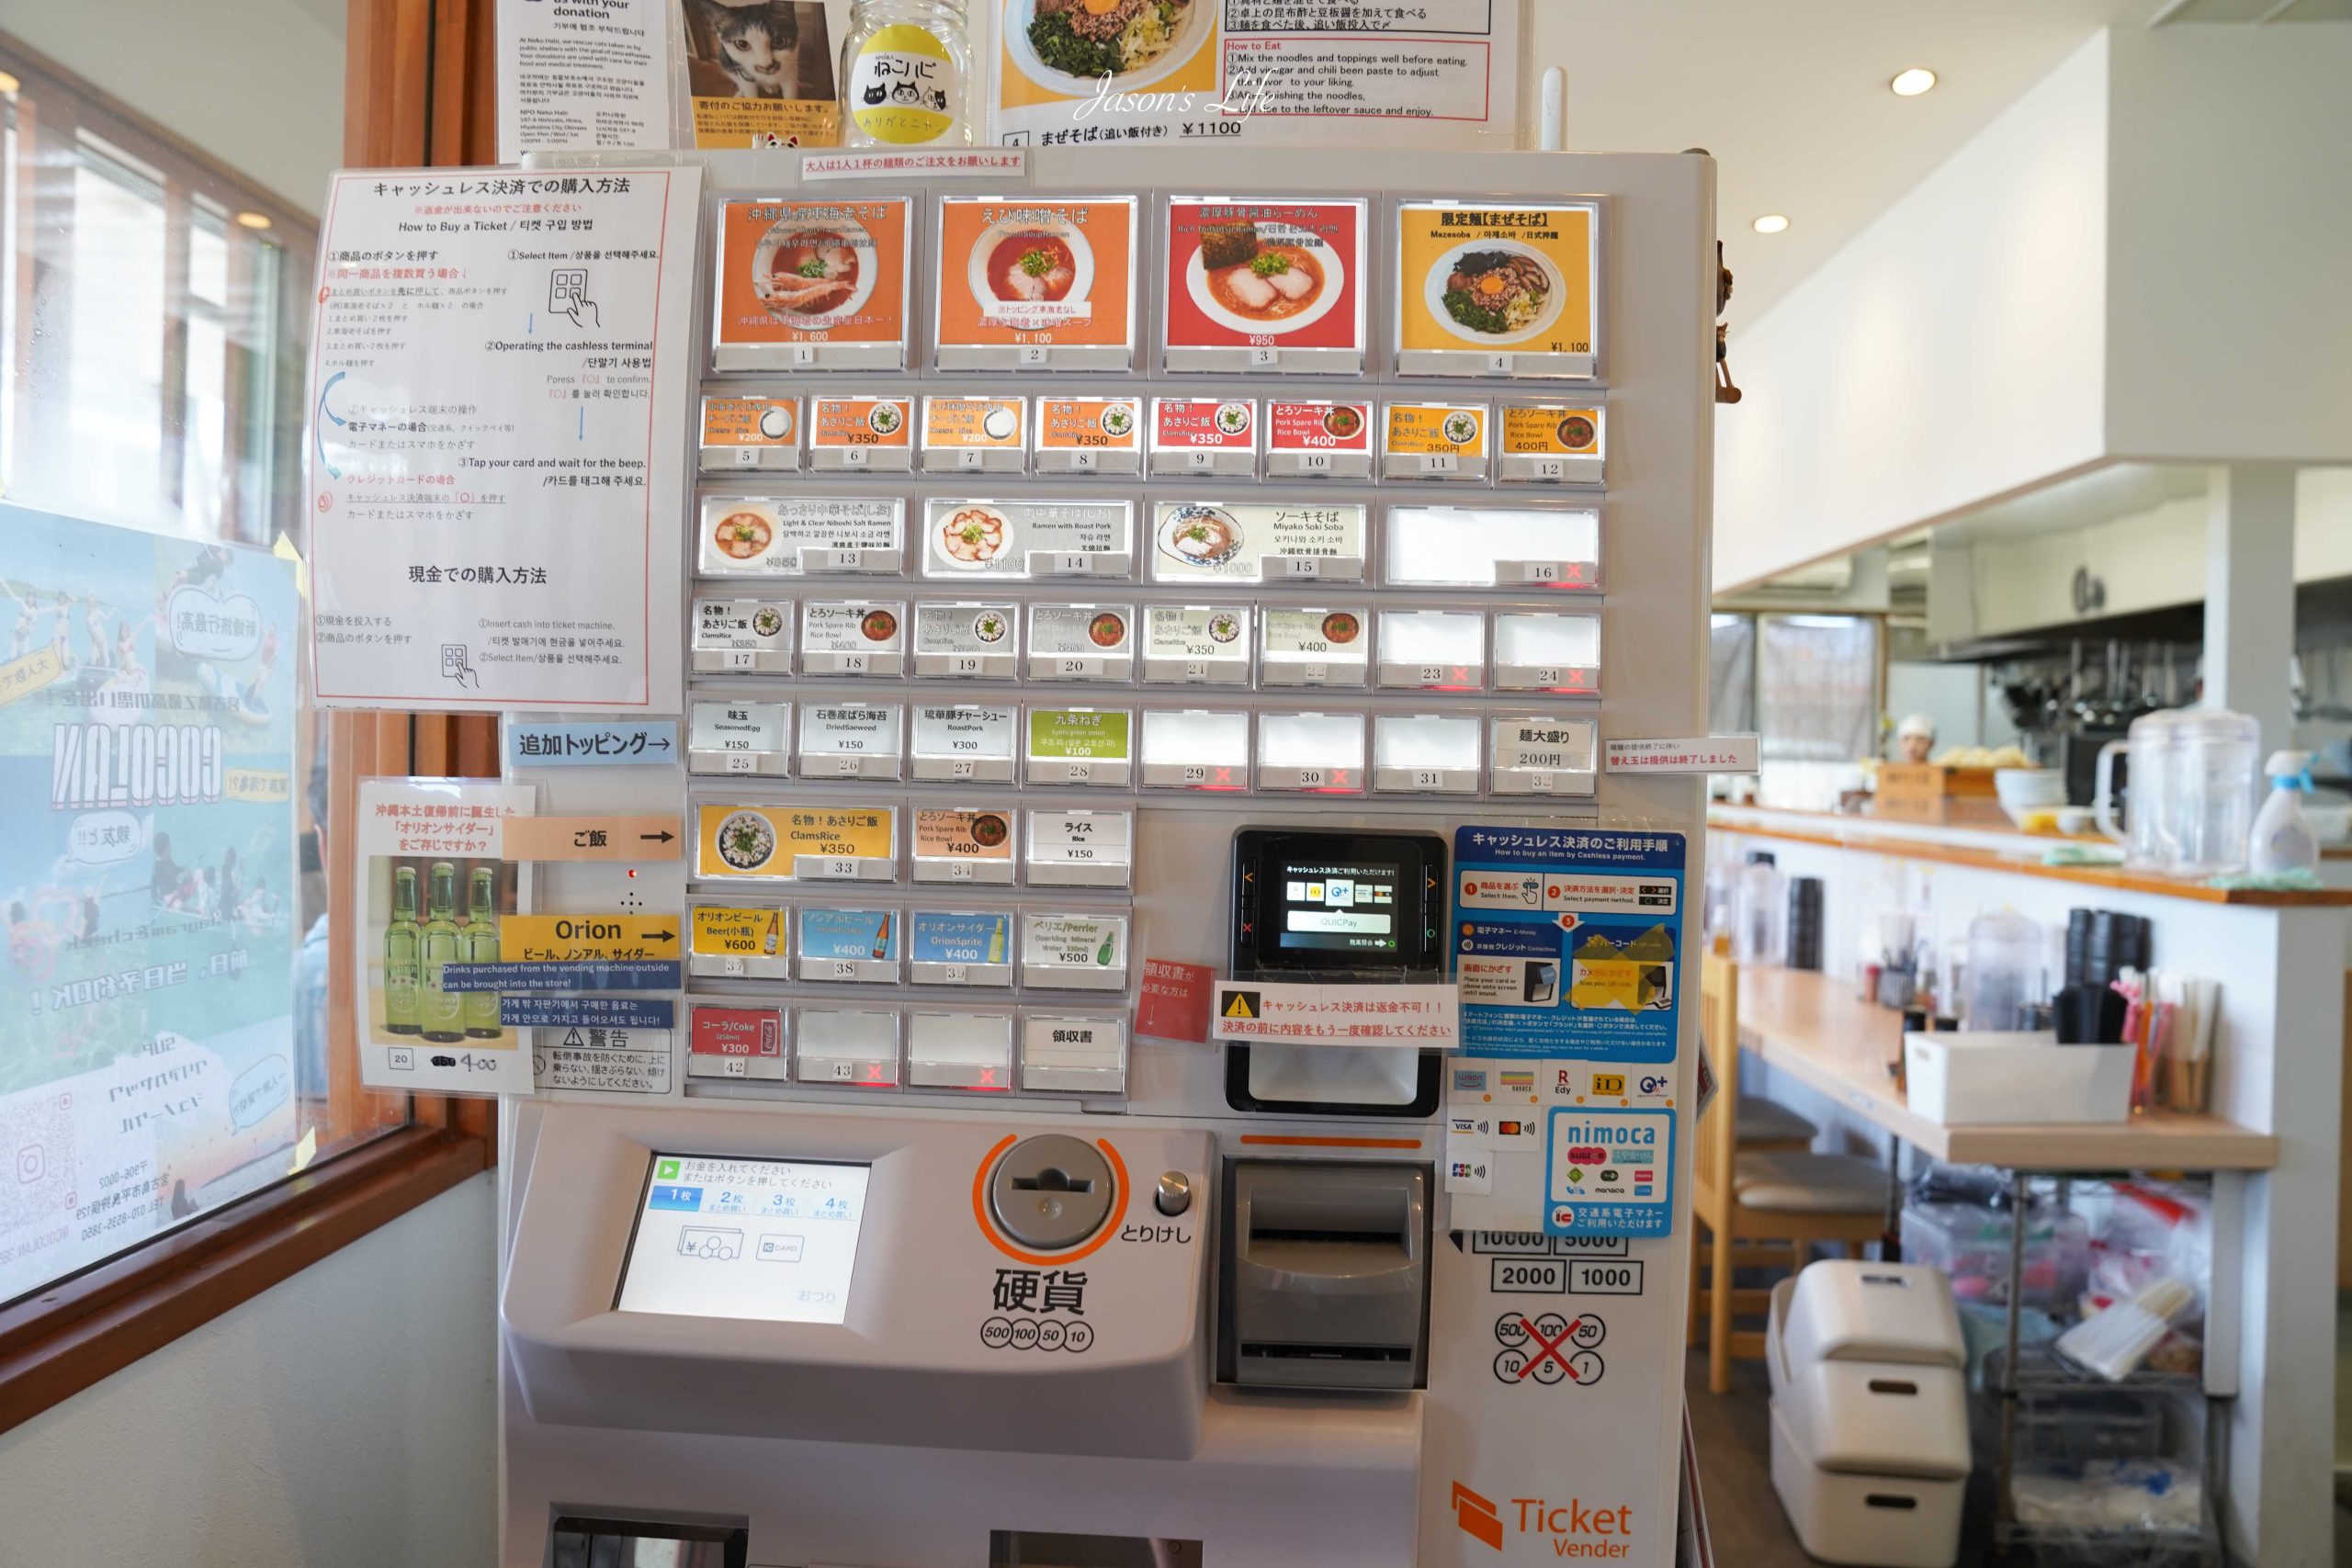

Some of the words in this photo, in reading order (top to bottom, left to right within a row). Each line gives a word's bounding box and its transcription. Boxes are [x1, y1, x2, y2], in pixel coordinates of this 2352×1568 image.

[554, 7, 609, 18] donation
[1317, 66, 1337, 74] chili
[1340, 66, 1363, 75] been
[1367, 67, 1393, 77] paste
[1410, 68, 1439, 77] adjust
[1307, 92, 1323, 100] the
[1327, 92, 1365, 101] noodles,
[698, 100, 829, 114] 寄付のご協力お願いします。
[1314, 105, 1351, 114] leftover
[1385, 107, 1402, 116] and
[1406, 107, 1433, 118] enjoy.
[373, 177, 630, 197] キャッシュレス決済での購入方法
[982, 208, 1088, 224] えび味噌そば
[399, 221, 422, 232] How
[426, 222, 436, 231] to
[440, 221, 460, 233] Buy
[474, 220, 507, 231] Ticket
[520, 220, 541, 231] 티켓
[546, 220, 566, 231] 구입
[571, 220, 593, 231] 방법
[547, 341, 562, 351] the
[565, 340, 608, 351] cashless
[612, 340, 653, 351] terminal
[1250, 334, 1274, 346] ¥950
[1276, 406, 1334, 416] とろソーキ丼
[821, 417, 865, 426] あさりご飯
[847, 434, 878, 444] ¥350
[1303, 436, 1336, 446] ¥400
[1427, 444, 1460, 453] 350円
[1516, 442, 1548, 451] 400円
[489, 460, 509, 469] your
[514, 458, 535, 468] card
[537, 458, 555, 468] and
[559, 458, 580, 468] wait
[582, 458, 597, 468] for
[600, 458, 616, 468] the
[619, 458, 646, 470] beep.
[346, 474, 455, 486] クレジットカードの場合
[1276, 511, 1339, 523] ソーキそば
[408, 566, 547, 585] 現金での購入方法
[1298, 642, 1327, 652] ¥400
[728, 710, 748, 721] 味玉
[816, 710, 888, 721] 石巻産ばら海苔
[1056, 715, 1101, 726] 九条ねぎ
[715, 724, 761, 732] SeasonedEgg
[1520, 729, 1569, 743] 麺大盛り
[520, 732, 648, 756] 追加トッピング
[725, 740, 749, 750] ¥150
[953, 741, 978, 750] ¥300
[1066, 746, 1091, 756] ¥100
[1520, 753, 1560, 765] 200円
[1611, 755, 1737, 765] 替え玉は提供は終了しました
[395, 821, 493, 836] 「オリオンサイダー」
[1065, 822, 1092, 833] ライス
[573, 829, 607, 847] ご飯
[790, 830, 841, 841] ClamsRice
[399, 839, 487, 852] をご存じですか？
[1473, 833, 1668, 852] キャッシュレス決済のご利用手順
[1522, 850, 1535, 858] buy
[1612, 852, 1645, 861] payment.
[1481, 882, 1519, 890] 商品を選ぶ
[698, 912, 763, 922] オリオンビール
[919, 922, 996, 932] オリオンサイダー
[1321, 919, 1357, 928] QUICPay
[555, 919, 621, 941] Orion
[707, 927, 753, 937] Beer(小瓶)
[725, 940, 755, 950] ¥600
[931, 937, 982, 946] OrionSprite
[524, 948, 654, 960] ビール、ノンアル、サイダー
[1059, 953, 1088, 962] ¥500
[443, 964, 469, 974] Drinks
[471, 965, 517, 976] purchased
[520, 964, 540, 974] from
[543, 964, 557, 973] the
[560, 964, 594, 975] vending
[596, 964, 633, 973] machine
[636, 964, 669, 972] outside
[443, 980, 458, 989] can
[460, 980, 471, 989] be
[474, 979, 507, 991] brought
[510, 979, 528, 988] into
[531, 978, 544, 987] the
[548, 978, 571, 988] store!
[703, 1021, 754, 1032] コーラ/Coke
[1222, 1021, 1451, 1037] 決済の前に内容をもう一度確認してください
[1053, 1030, 1093, 1044] 領収書
[721, 1043, 750, 1054] ¥300
[460, 1053, 497, 1071] 400
[726, 1061, 743, 1073] 42
[834, 1065, 851, 1077] 43
[553, 1076, 654, 1089] ないようにしてください。
[1555, 1086, 1570, 1095] Edy
[1568, 1121, 1655, 1144] nimoca
[684, 1161, 791, 1175] お金を入れてください
[684, 1173, 831, 1189] またはボタンを押してください
[1577, 1207, 1663, 1218] 交通系電子マネー
[1577, 1217, 1663, 1228] ご利用いただけます
[1121, 1224, 1192, 1244] とりけし
[1502, 1268, 1555, 1284] 2000
[1582, 1269, 1631, 1286] 1000
[992, 1269, 1087, 1314] 硬貨
[985, 1327, 1009, 1338] 500
[1014, 1328, 1035, 1340] 100
[1042, 1329, 1059, 1341] 50
[1069, 1332, 1084, 1343] 10
[1511, 1498, 1632, 1536] Ticket
[1553, 1540, 1630, 1559] Vender
